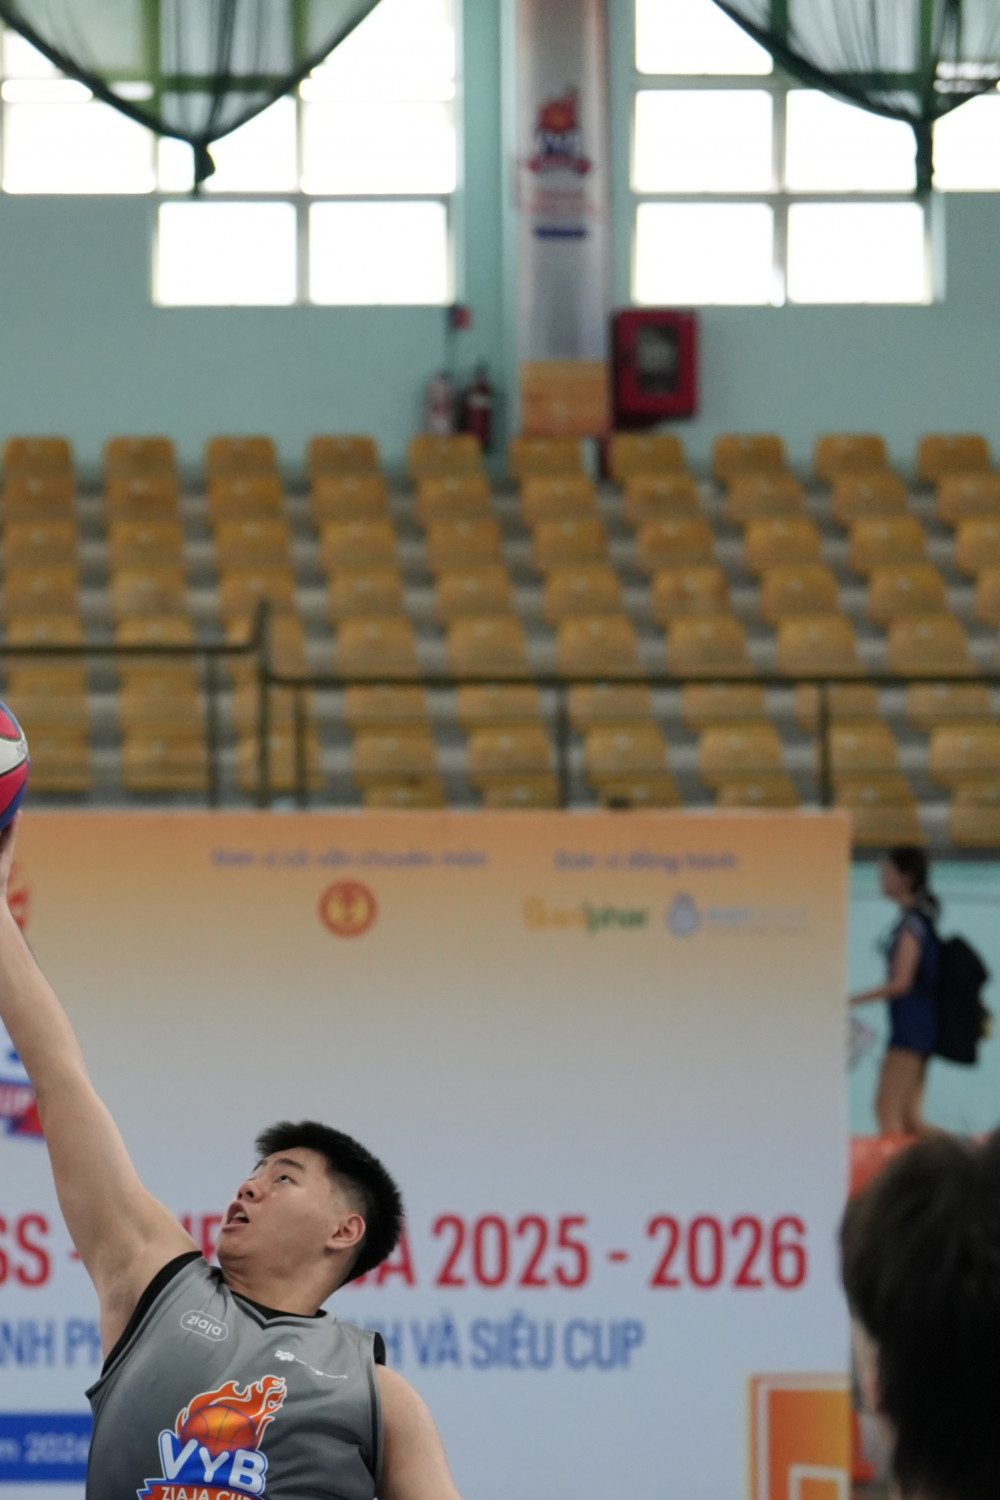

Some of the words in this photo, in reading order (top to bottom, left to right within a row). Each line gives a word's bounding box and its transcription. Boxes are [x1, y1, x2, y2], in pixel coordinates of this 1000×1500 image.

[432, 1214, 590, 1289] 2025
[647, 1214, 808, 1289] 2026
[409, 1309, 462, 1368] VÀ
[470, 1310, 554, 1370] SIÊU
[564, 1318, 645, 1370] CUP
[160, 1430, 268, 1494] VYB
